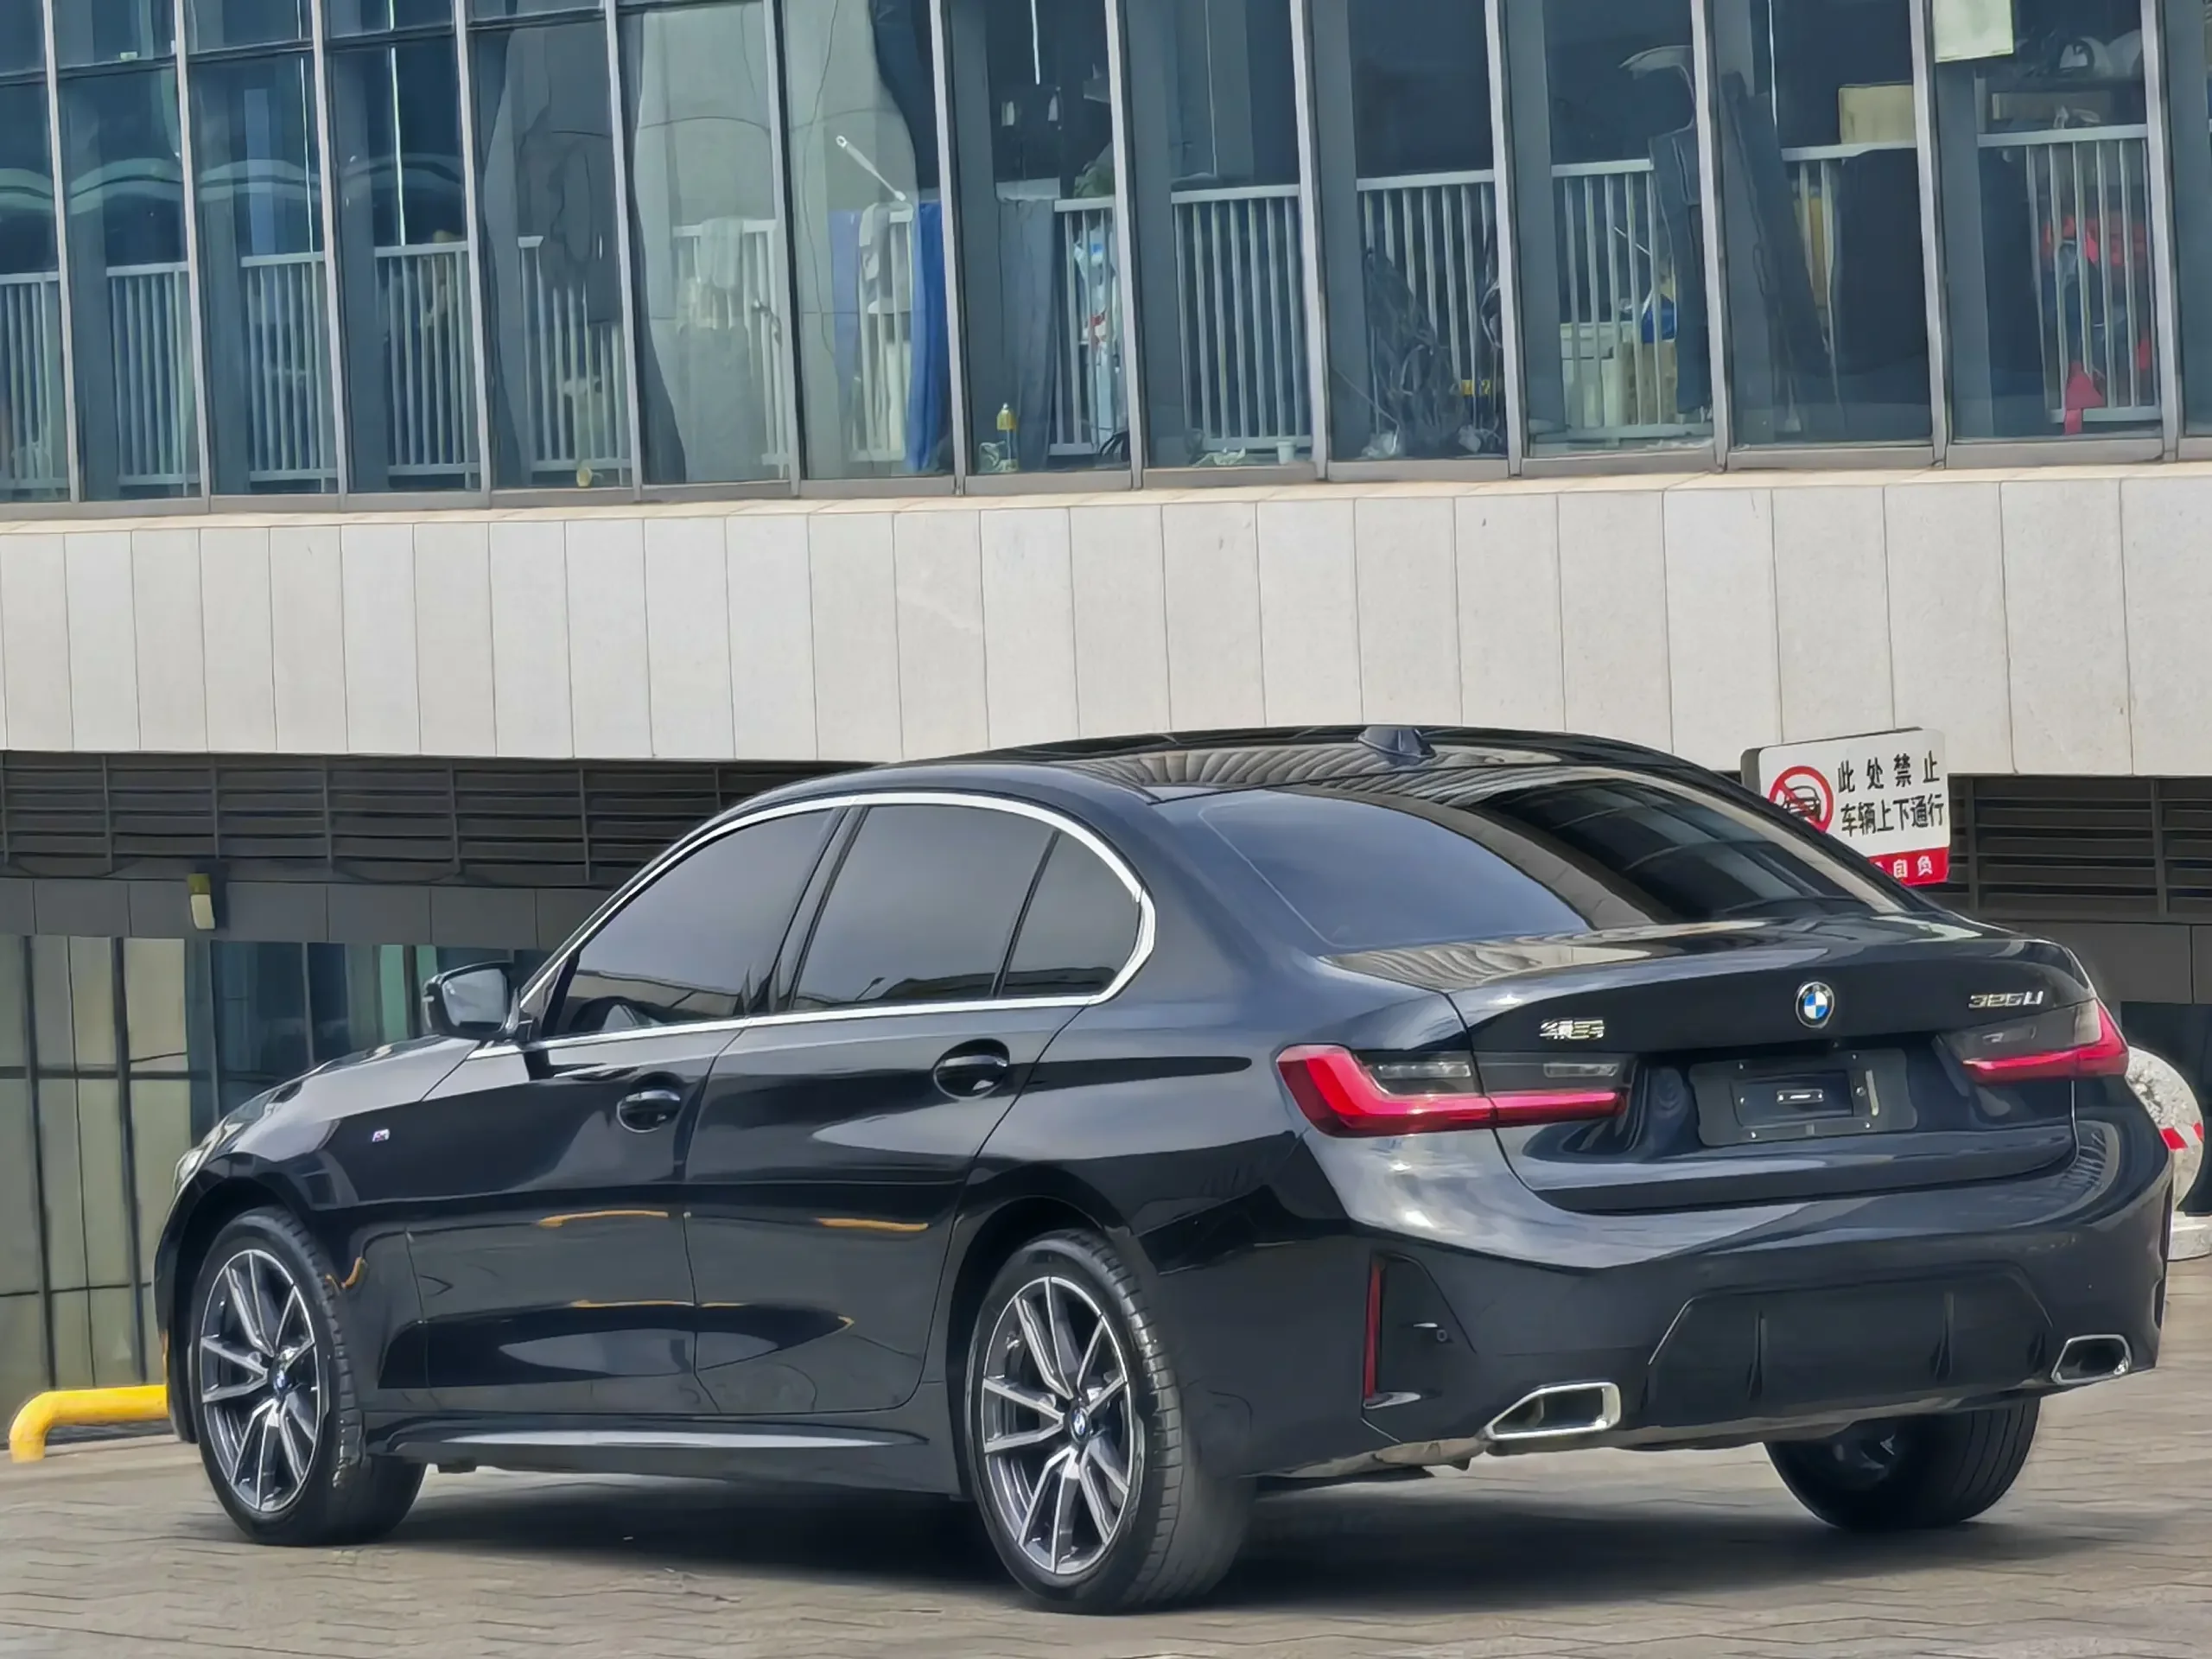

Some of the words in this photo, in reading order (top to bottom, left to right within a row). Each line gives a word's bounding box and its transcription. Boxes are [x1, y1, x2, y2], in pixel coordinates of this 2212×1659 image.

[1838, 750, 1940, 793] 此处禁止
[1840, 794, 1944, 837] 车辆上下通行
[1874, 855, 1934, 879] 自负
